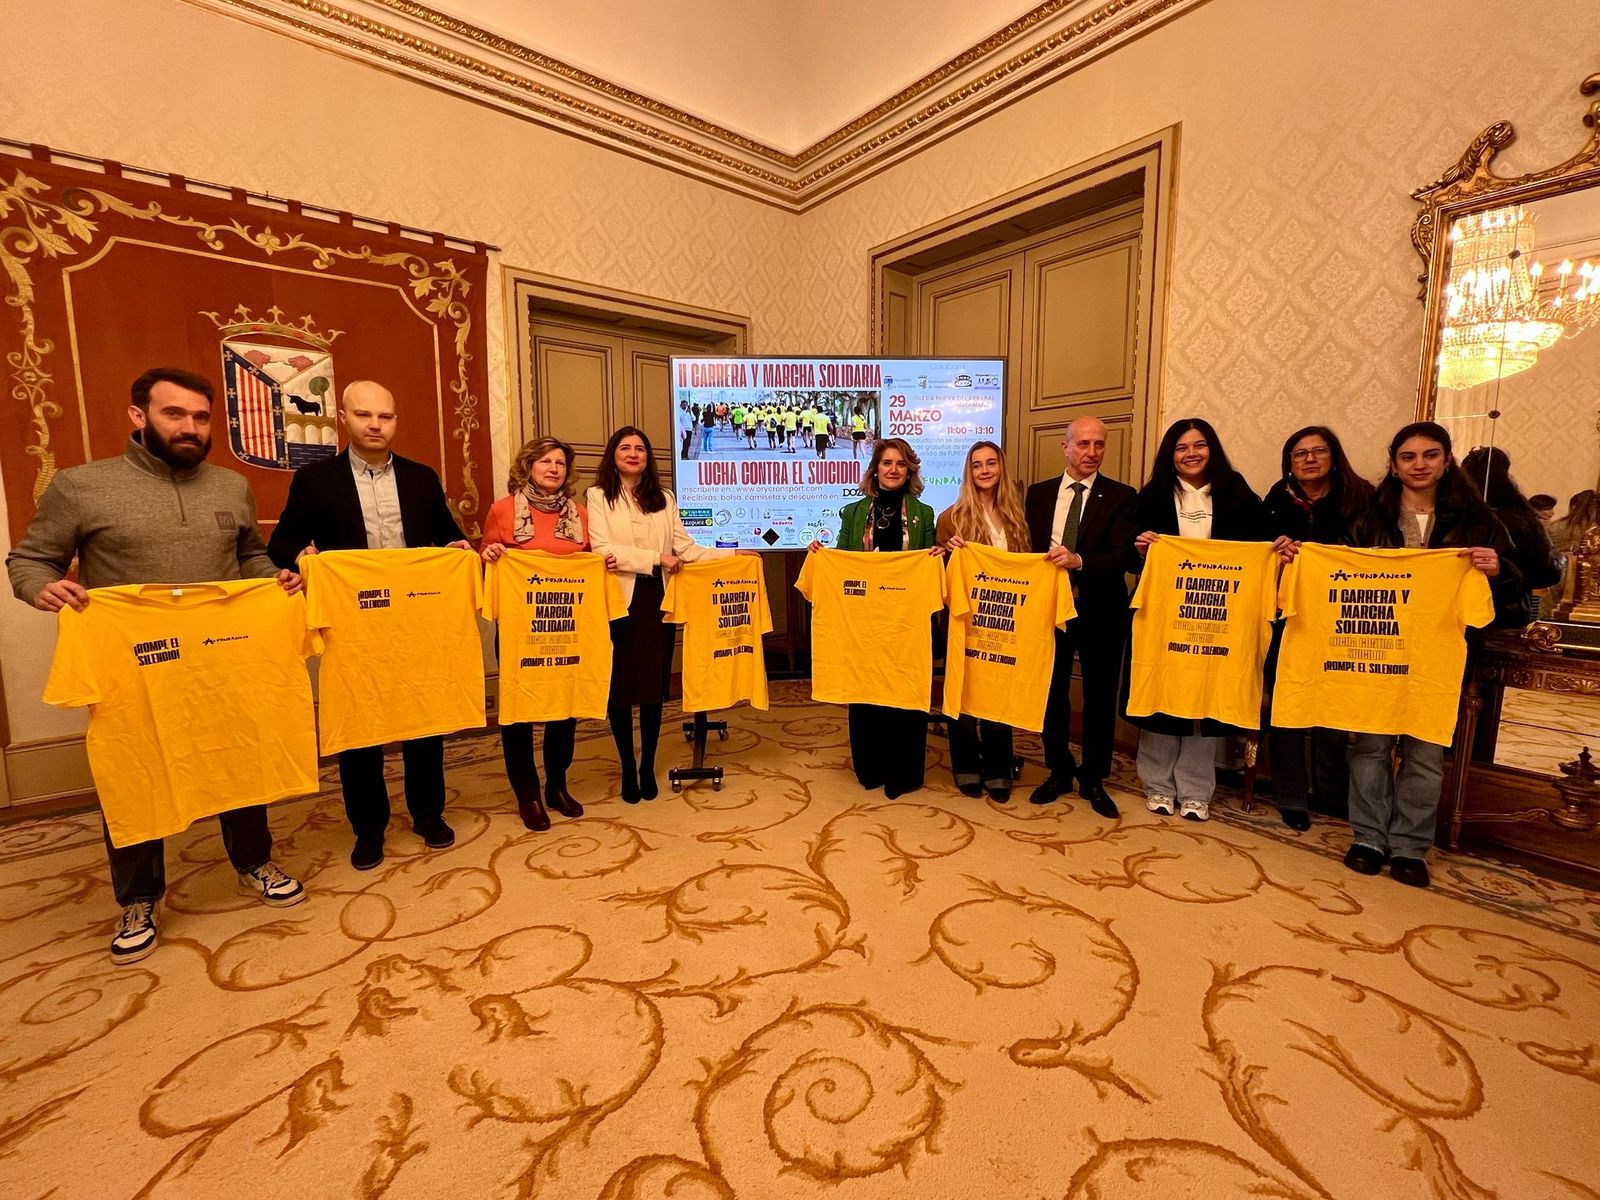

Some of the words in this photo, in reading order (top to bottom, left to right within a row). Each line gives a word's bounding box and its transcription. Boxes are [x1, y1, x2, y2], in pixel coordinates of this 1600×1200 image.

[678, 363, 688, 388] II
[691, 363, 747, 388] CARRERA
[750, 363, 759, 388] Y
[763, 363, 816, 388] MARCHA
[820, 363, 882, 388] SOLIDARIA
[889, 395, 906, 408] 29
[889, 410, 942, 422] MARZO
[889, 423, 923, 436] 2025
[947, 426, 966, 434] 11:00
[975, 426, 994, 434] 13:10
[698, 462, 737, 485] LUCHA
[741, 461, 788, 485] CONTRA
[792, 461, 804, 484] EL
[808, 461, 860, 484] SUICIDIO
[1176, 576, 1183, 589] II
[1186, 577, 1229, 593] CARRERA
[1233, 580, 1240, 594] Y
[384, 589, 390, 597] EL
[526, 592, 533, 604] II
[536, 592, 575, 604] CARRERA
[578, 592, 584, 605] Y
[713, 594, 718, 604] II
[720, 592, 749, 604] CARRERA
[751, 592, 756, 602] Y
[971, 587, 978, 599] II
[979, 588, 1017, 605] CARRERA
[1020, 594, 1026, 606] Y
[1184, 592, 1225, 607] MARCHA
[1329, 589, 1337, 603] II
[1341, 589, 1397, 604] CARRERA
[1401, 590, 1410, 604] Y
[536, 606, 573, 618] MARCHA
[721, 603, 748, 616] MARCHA
[978, 602, 1014, 618] MARCHA
[1178, 605, 1227, 621] SOLIDARIA
[1341, 605, 1394, 620] MARCHA
[531, 620, 575, 632] SOLIDARIA
[719, 615, 751, 628] SOLIDARIA
[972, 614, 1015, 632] SOLIDARIA
[1335, 620, 1400, 636] SOLIDARIA
[134, 639, 168, 656] ¡ROMPE
[170, 638, 179, 648] EL
[1192, 645, 1199, 654] EL
[138, 649, 180, 666] SILENCIO!
[547, 657, 552, 666] EL
[981, 652, 987, 660] EL
[1324, 661, 1355, 672] ¡ROMPE
[1358, 662, 1366, 672] EL
[1369, 663, 1409, 675] SILENCIO!
